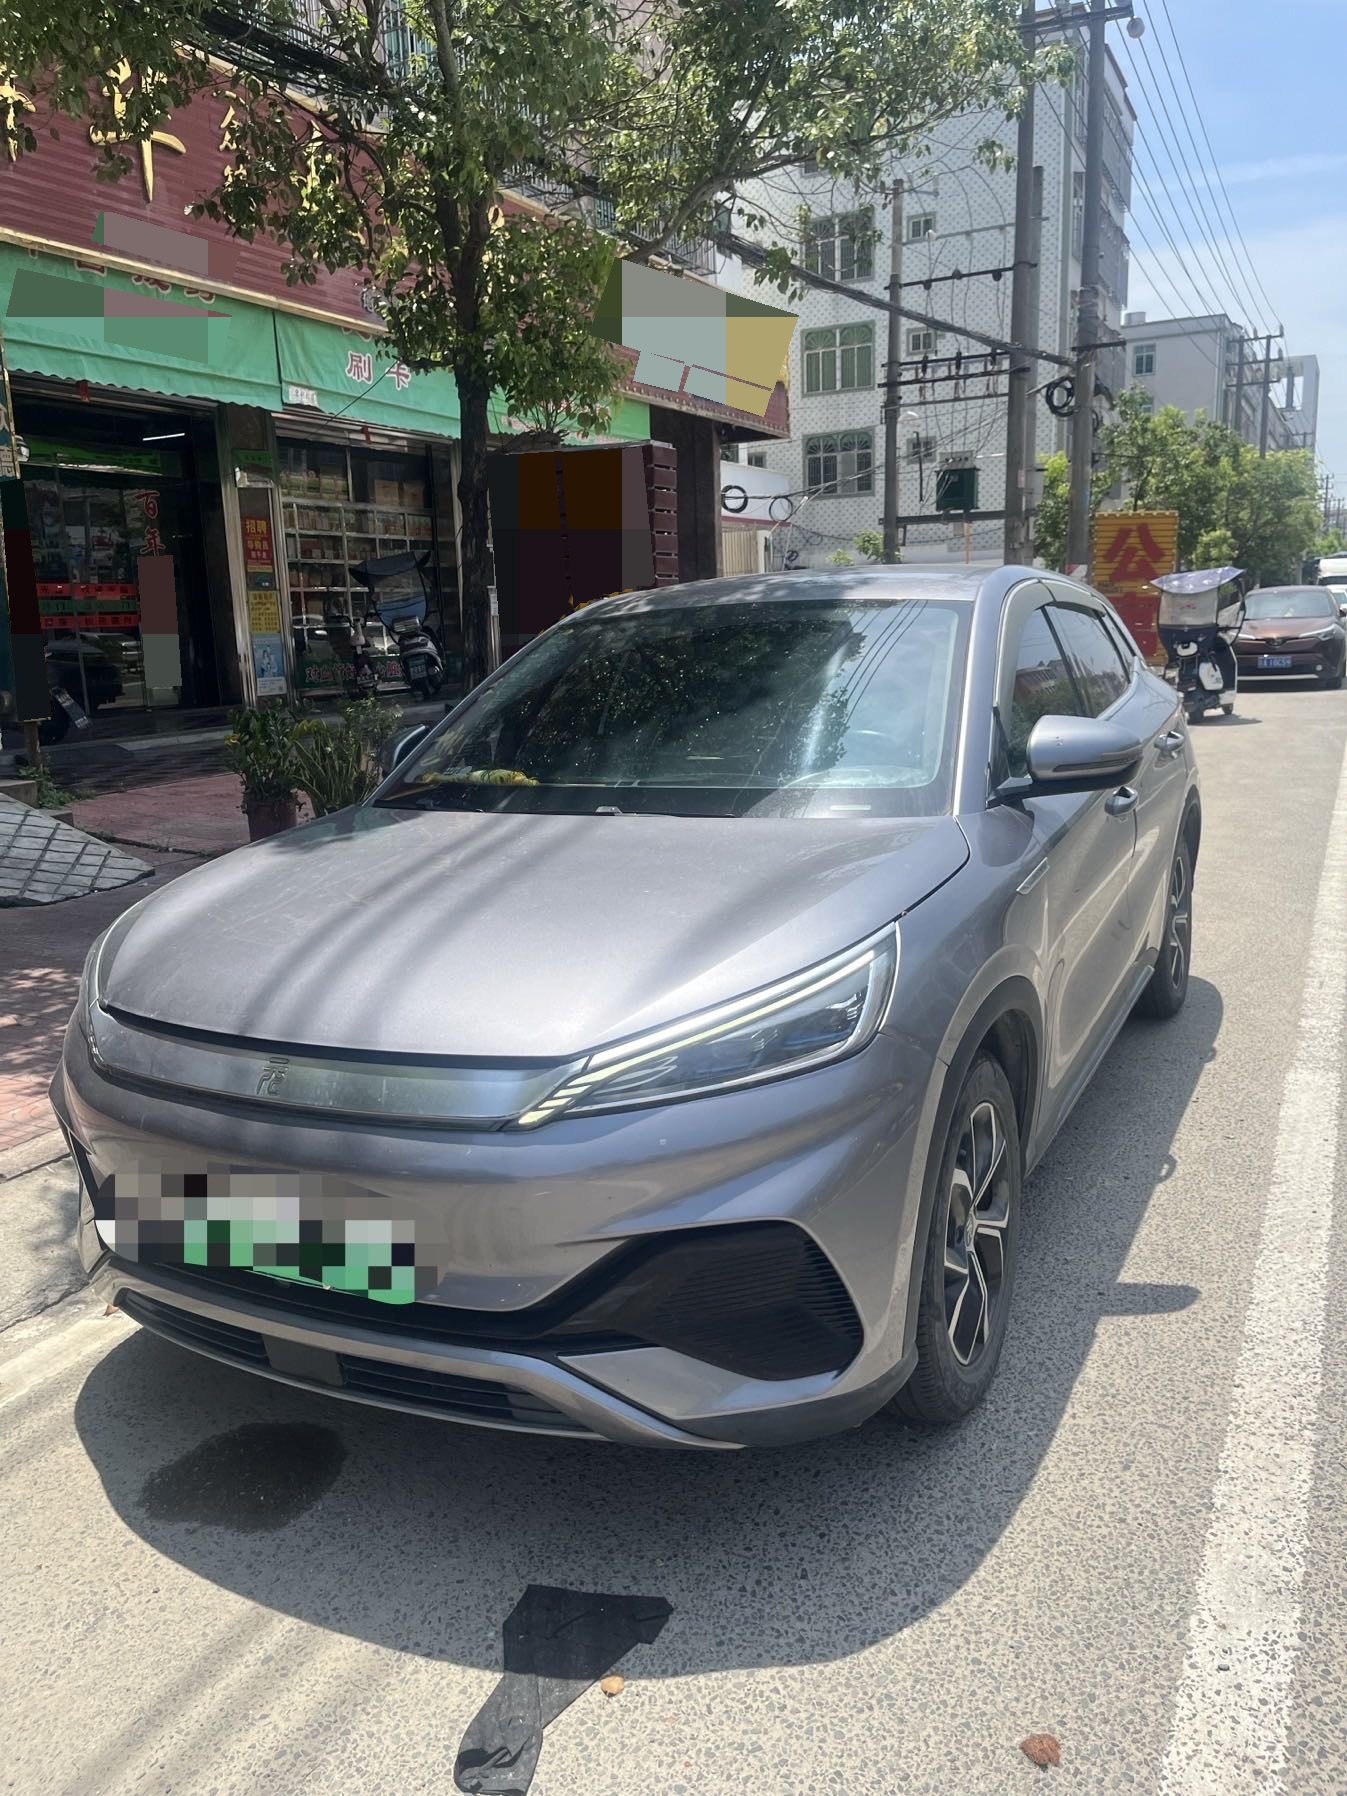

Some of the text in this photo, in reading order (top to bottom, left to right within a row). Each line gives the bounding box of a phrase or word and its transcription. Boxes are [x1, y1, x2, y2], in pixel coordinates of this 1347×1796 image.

[345, 350, 411, 390] 刷卡
[134, 490, 166, 556] 百年
[245, 519, 267, 535] 招聘
